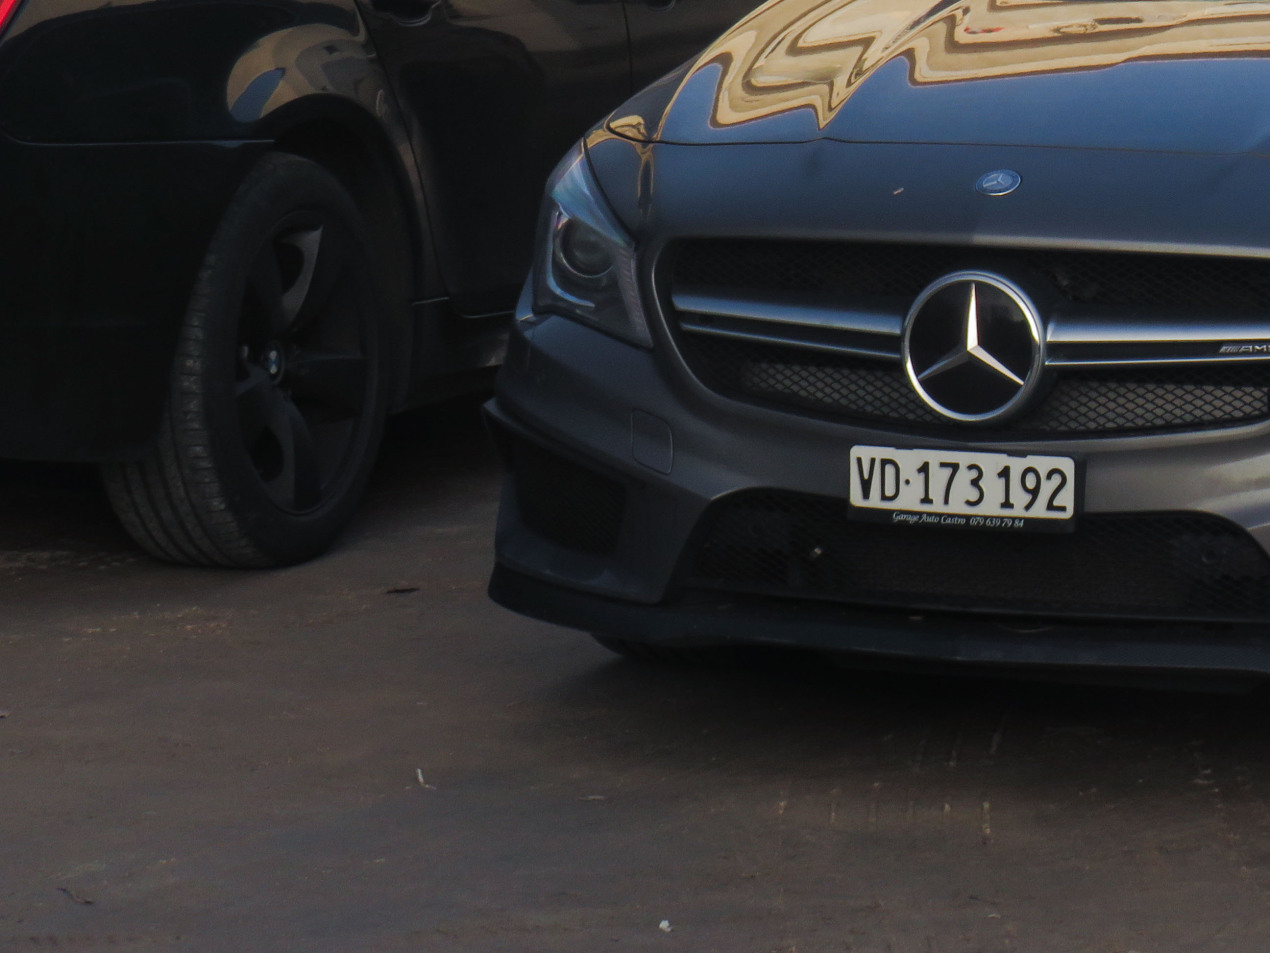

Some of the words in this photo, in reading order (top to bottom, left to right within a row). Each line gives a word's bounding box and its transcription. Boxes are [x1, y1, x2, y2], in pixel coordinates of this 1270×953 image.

[892, 511, 919, 524] Garage
[919, 513, 939, 524] Auto
[940, 514, 966, 525] Castro
[969, 516, 984, 526] 079
[985, 517, 1000, 527] 639
[1002, 518, 1013, 528] 79
[1013, 518, 1024, 528] 84
